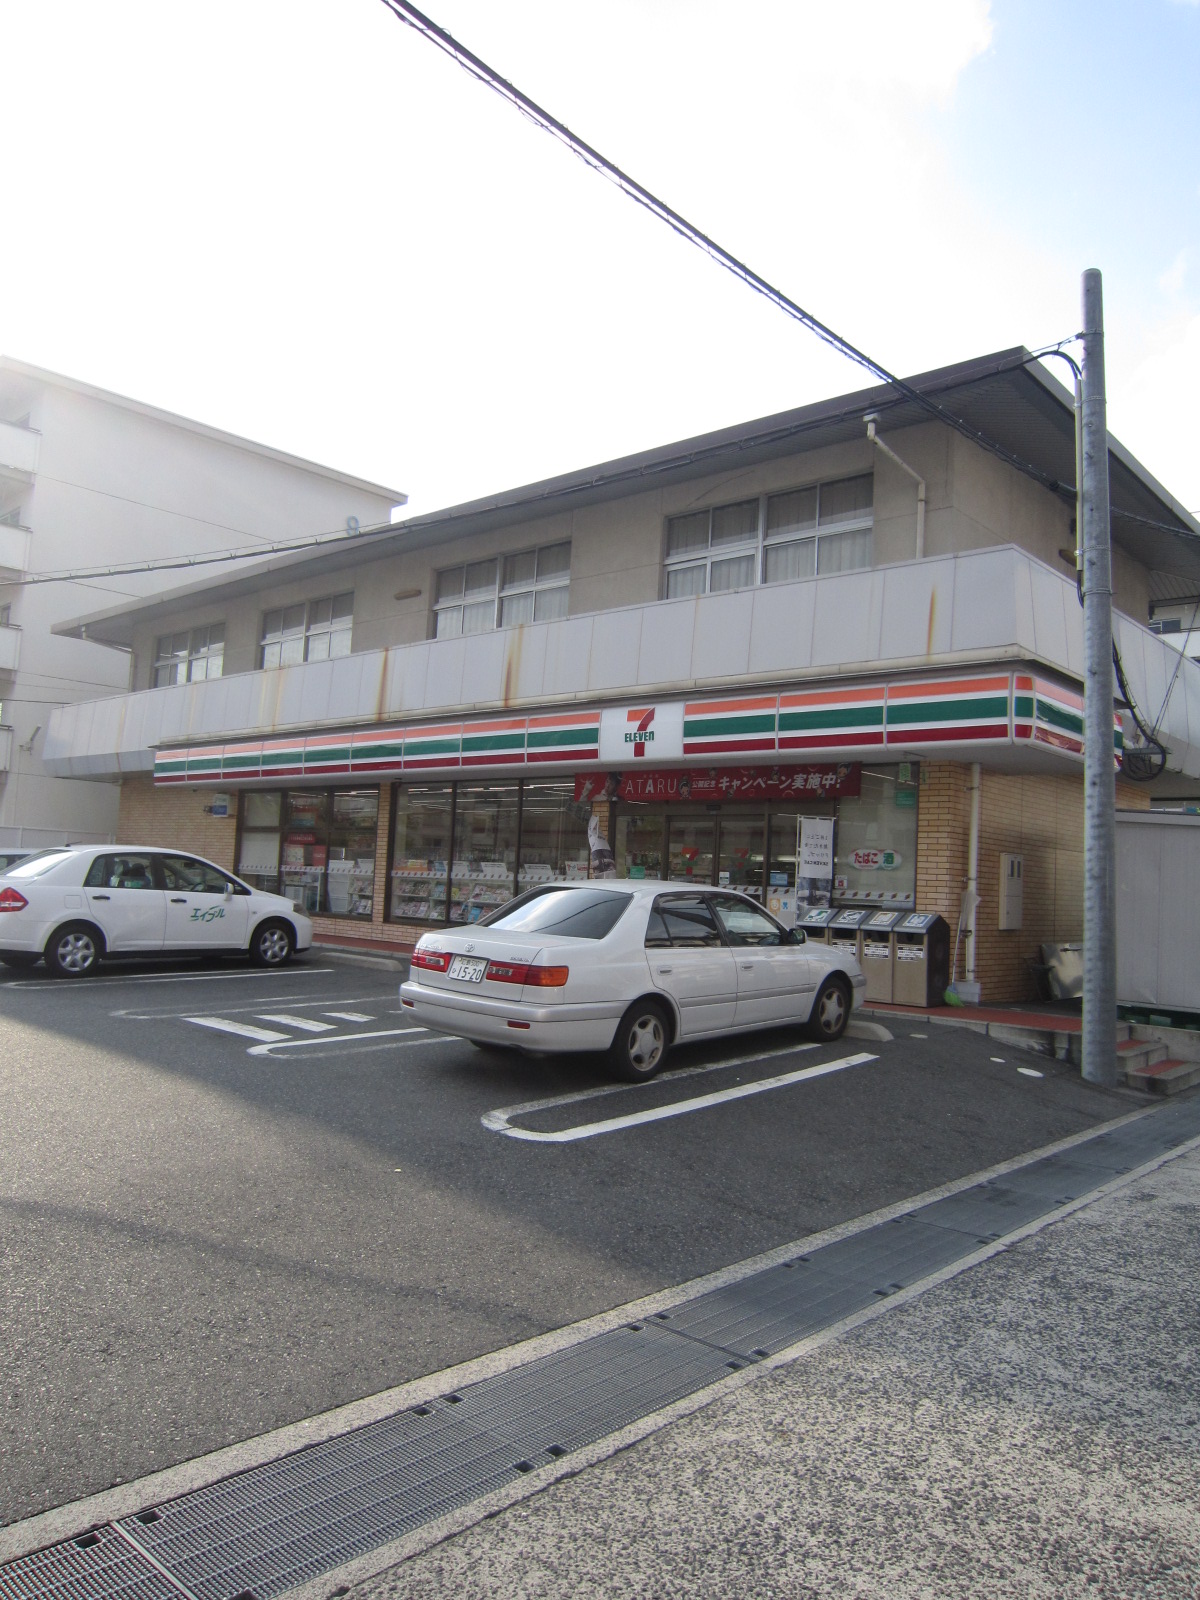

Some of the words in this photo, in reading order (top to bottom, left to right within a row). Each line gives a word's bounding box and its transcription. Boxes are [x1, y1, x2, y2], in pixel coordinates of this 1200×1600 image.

[627, 707, 656, 757] 7
[625, 779, 677, 794] ATARU
[854, 852, 878, 864] たばこ
[883, 852, 894, 864] 酒
[190, 905, 226, 922] エイブル
[457, 966, 482, 980] 15-20
